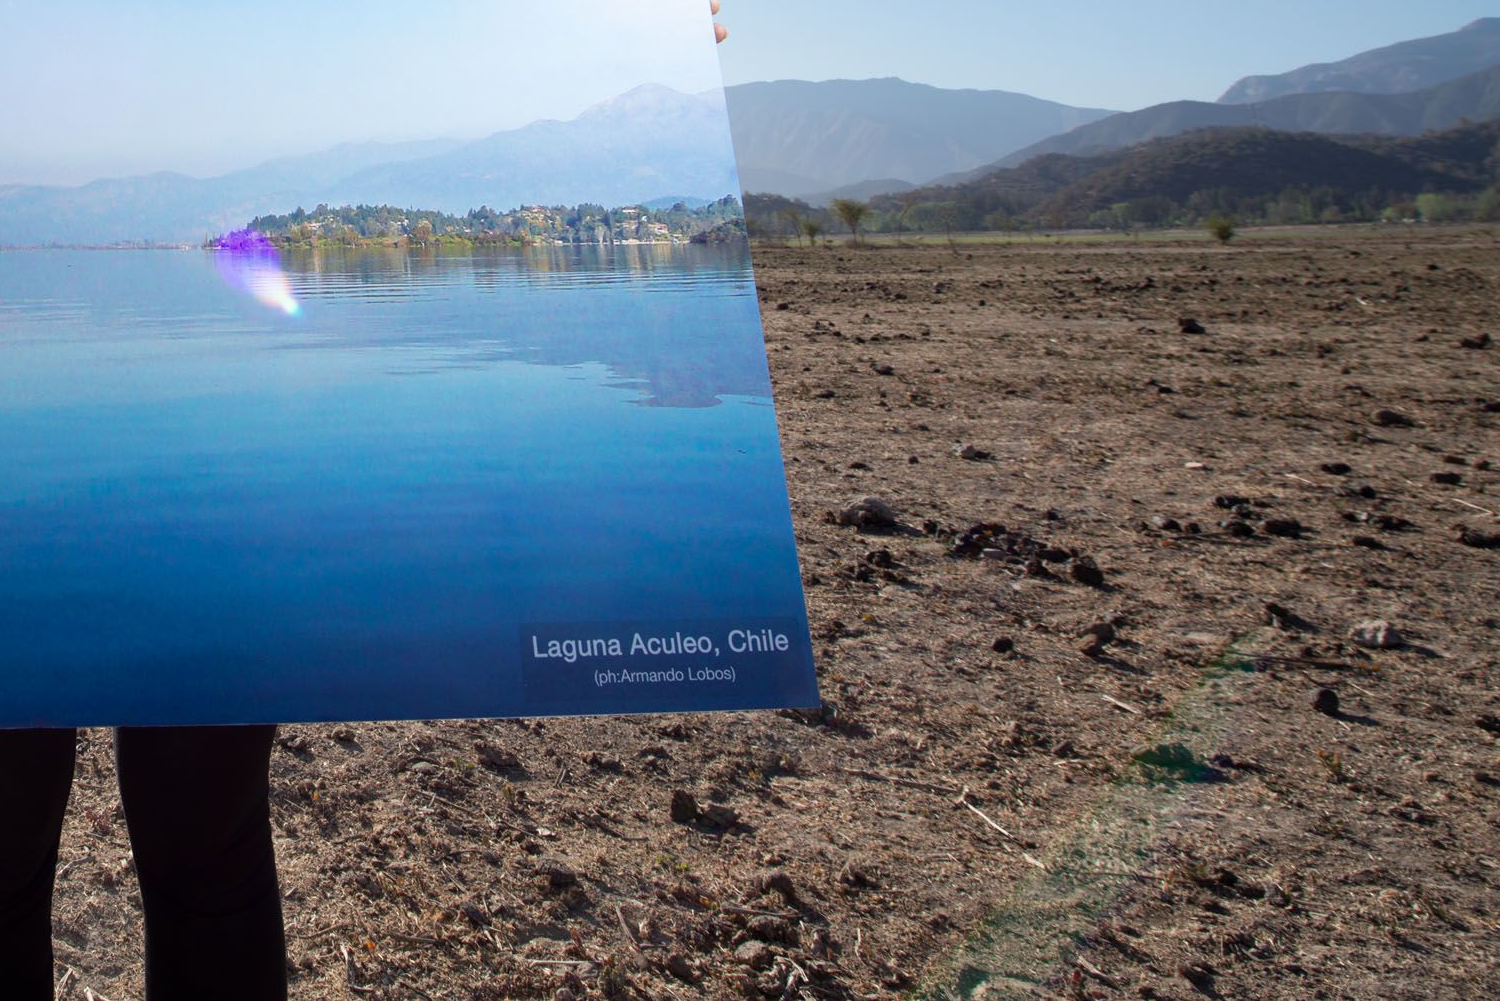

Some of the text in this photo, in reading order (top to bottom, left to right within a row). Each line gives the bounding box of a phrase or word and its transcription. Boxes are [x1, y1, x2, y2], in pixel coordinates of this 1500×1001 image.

[532, 629, 789, 662] Laguna Aculeo, Chile
[594, 666, 736, 687] (ph:Armando Lobos)
